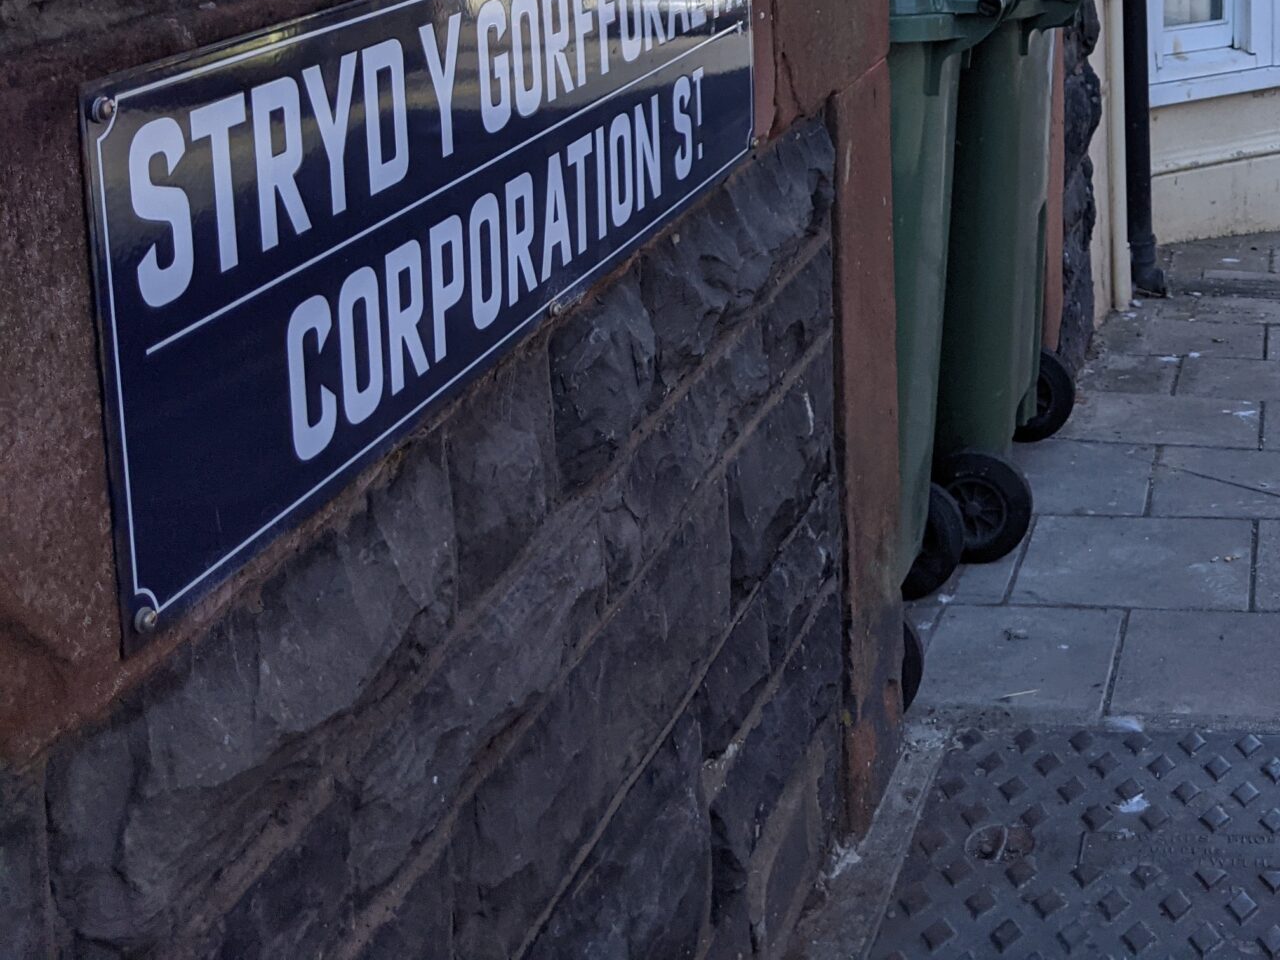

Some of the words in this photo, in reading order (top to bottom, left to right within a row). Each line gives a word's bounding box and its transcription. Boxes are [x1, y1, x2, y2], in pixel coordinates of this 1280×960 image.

[128, 38, 410, 308] STRYD
[419, 13, 462, 158] Y
[286, 96, 662, 462] CORPORATION
